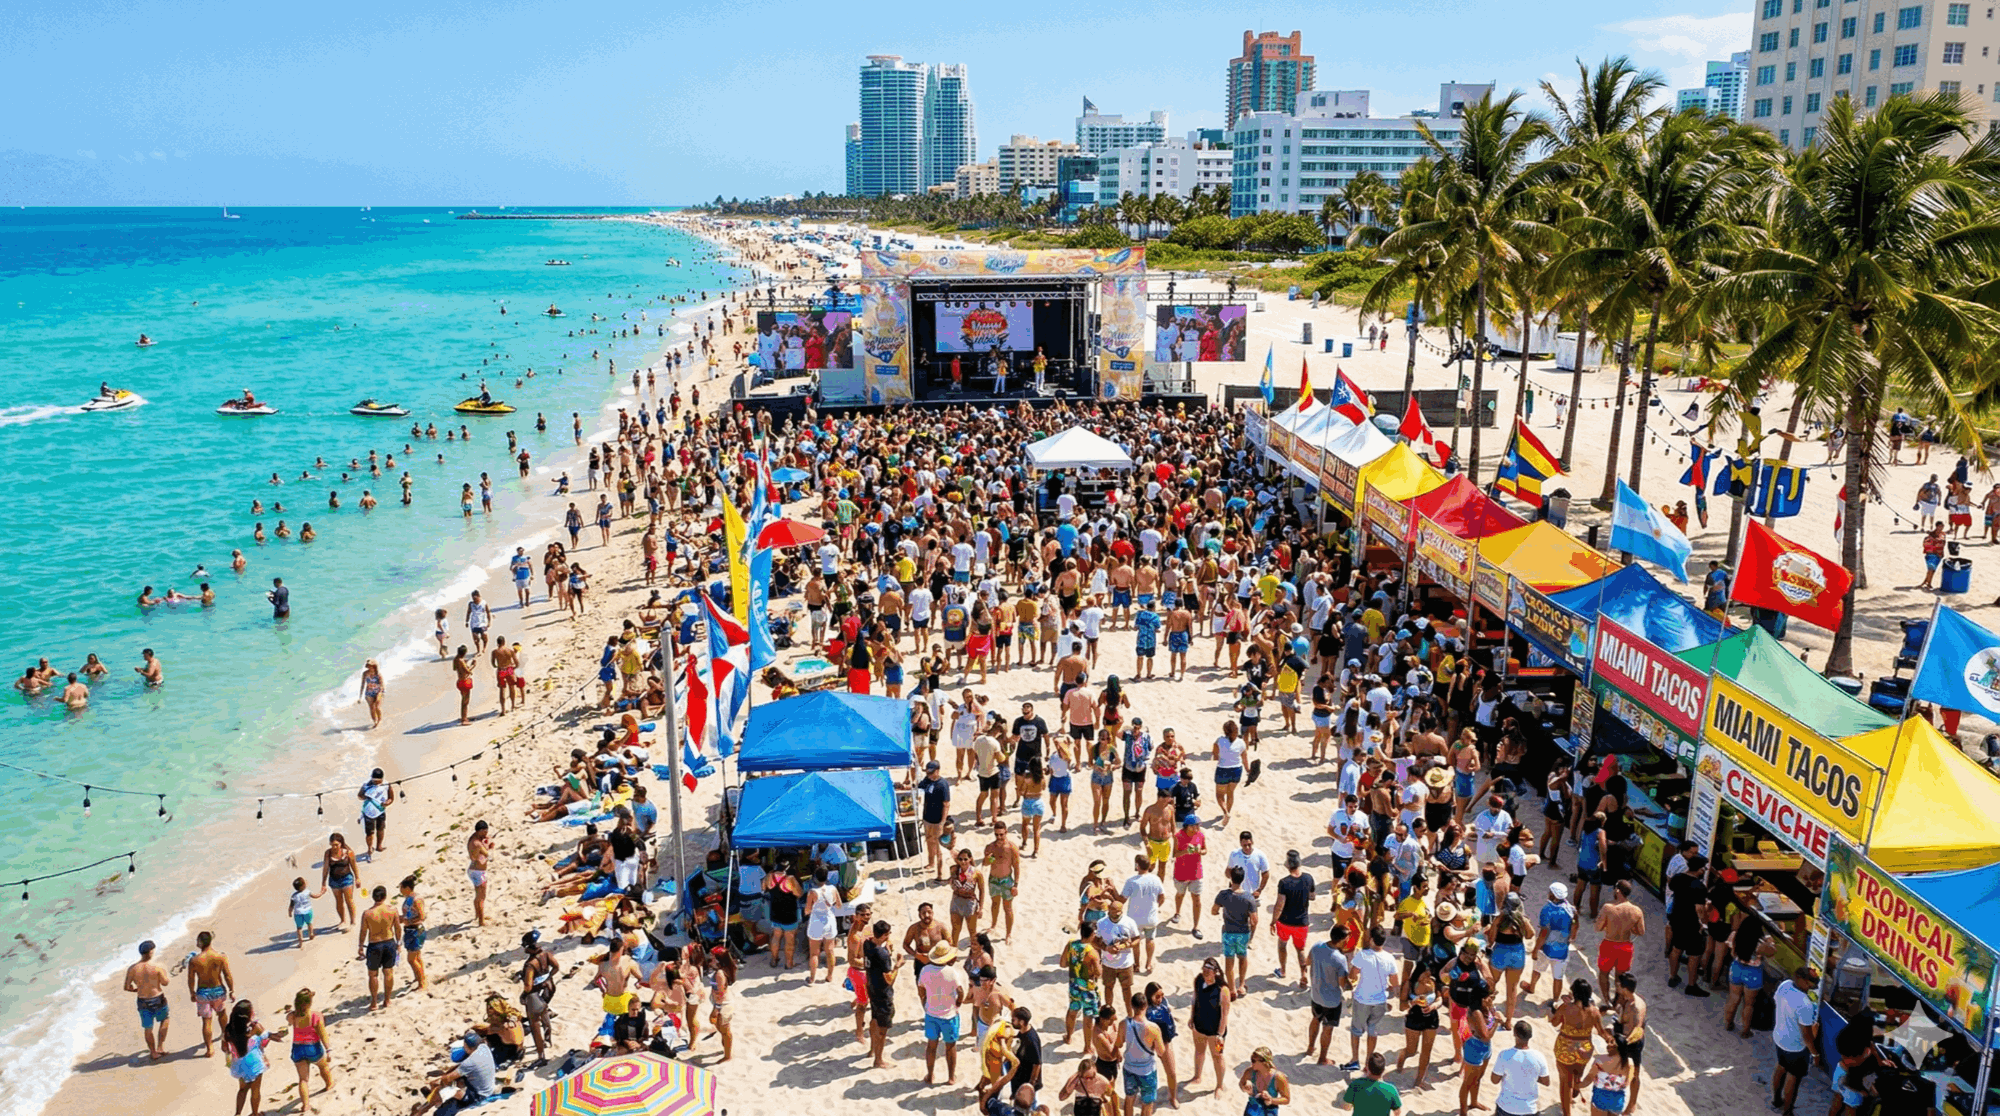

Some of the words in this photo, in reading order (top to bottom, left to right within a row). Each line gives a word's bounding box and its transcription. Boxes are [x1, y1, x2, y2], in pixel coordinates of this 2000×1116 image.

[1599, 630, 1648, 687] MIAMI
[1651, 660, 1702, 721] TACOS
[1713, 692, 1783, 768] MIAMI
[1786, 734, 1862, 818] TACOS
[1726, 769, 1829, 860] CEVICHE
[1856, 867, 1955, 967] TROPICAL
[1861, 908, 1939, 990] DRINKS
